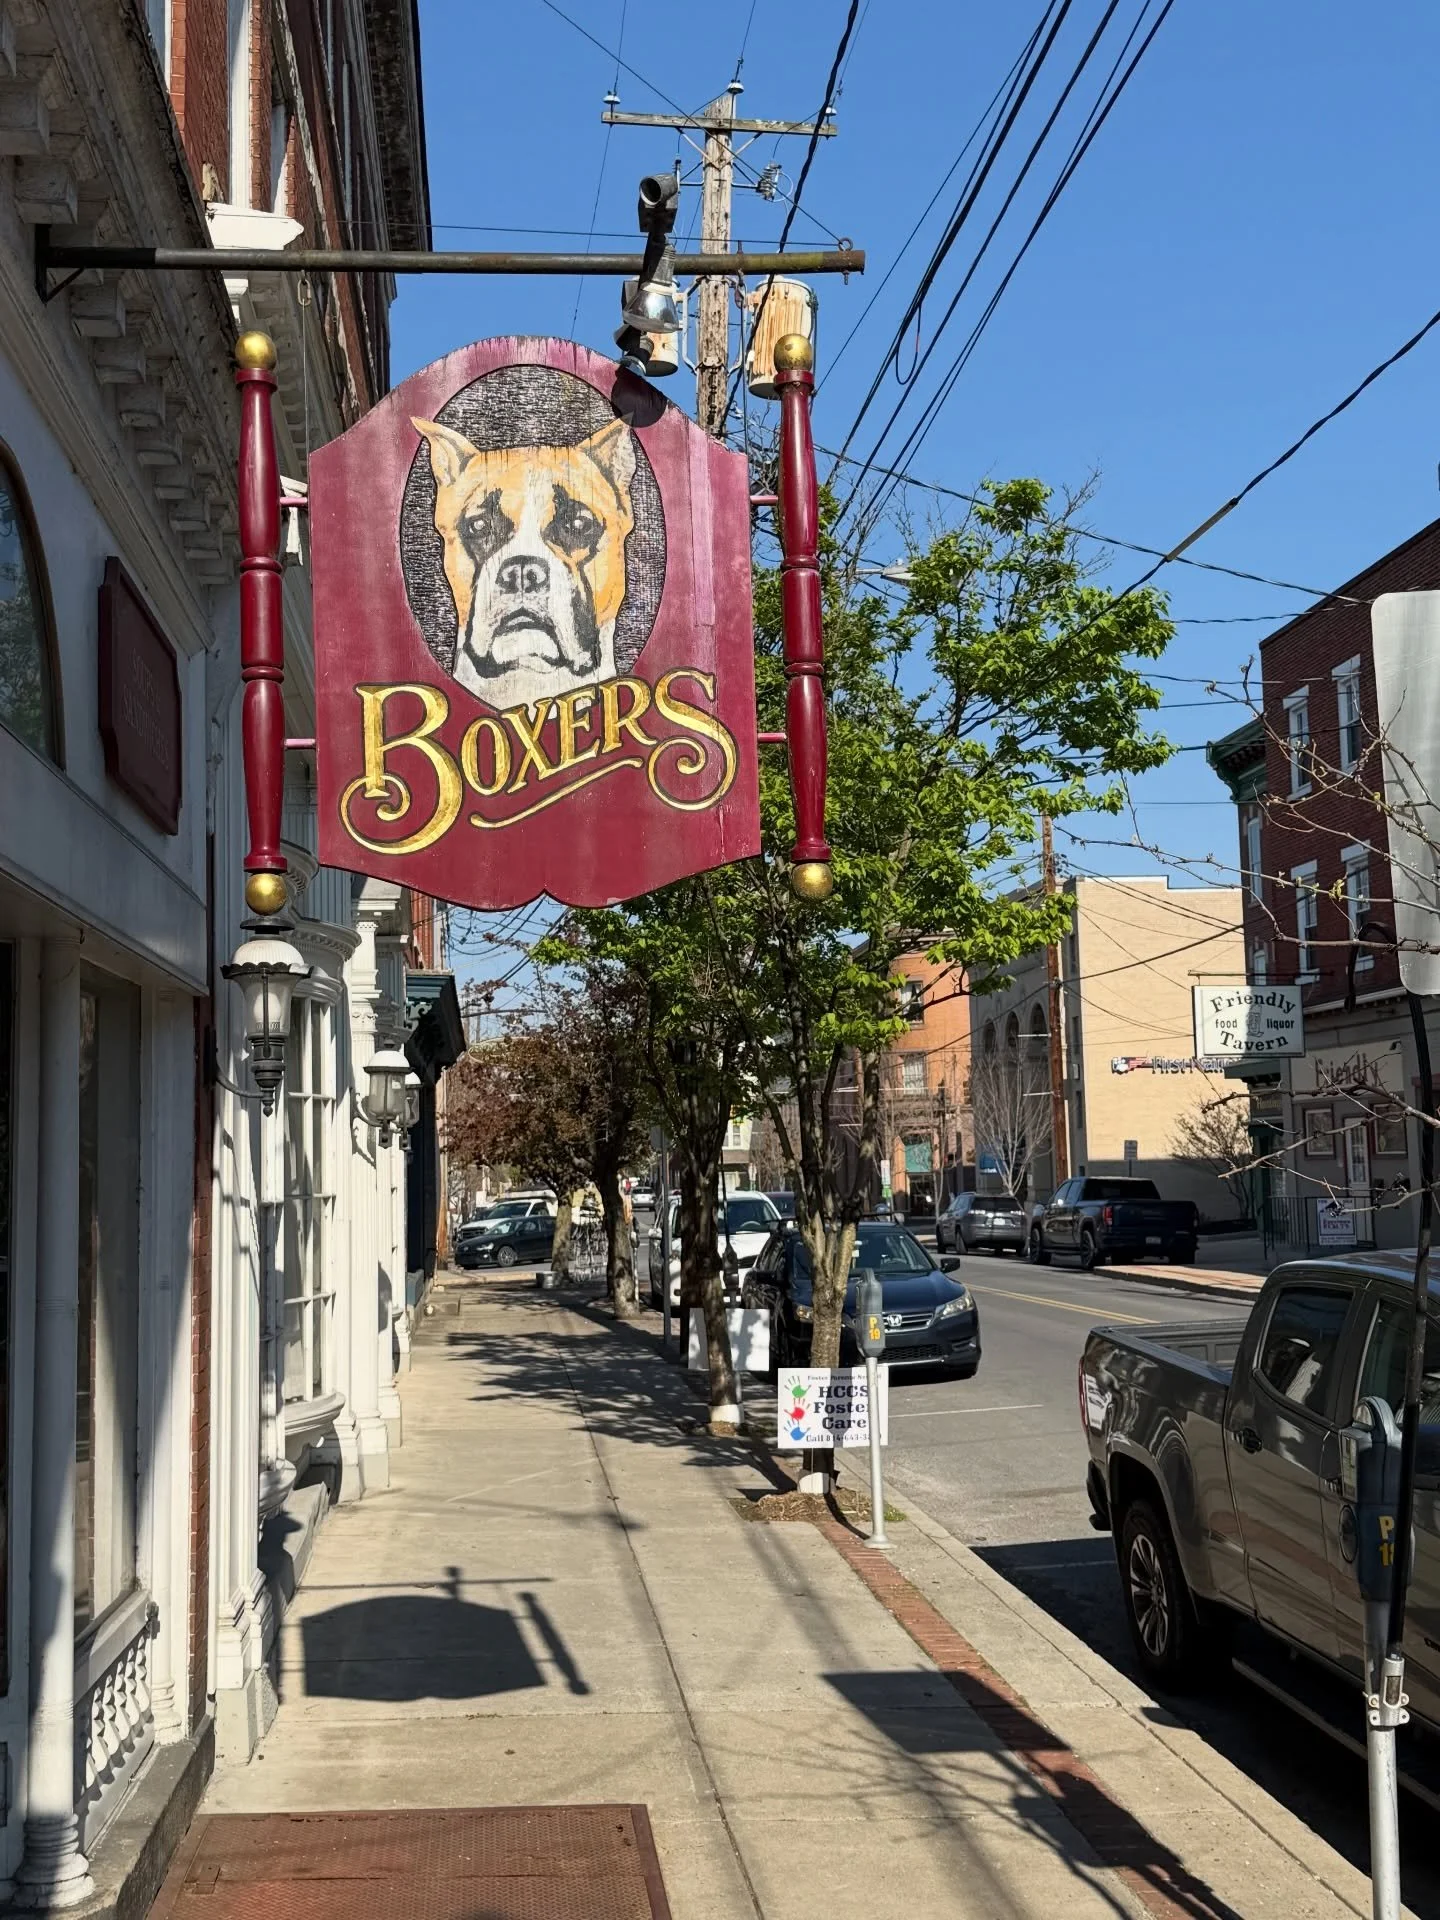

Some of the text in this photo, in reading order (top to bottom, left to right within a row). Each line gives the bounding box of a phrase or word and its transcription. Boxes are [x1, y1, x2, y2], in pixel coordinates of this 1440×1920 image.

[340, 668, 738, 855] BOXERS
[1210, 991, 1296, 1014] Friendly
[1215, 1018, 1295, 1031] food liquor
[1220, 1030, 1289, 1051] Tavern
[1152, 1056, 1187, 1074] First
[869, 1317, 878, 1328] P
[818, 1385, 869, 1398] HCCS
[822, 1416, 867, 1430] Care
[806, 1434, 824, 1442] Call
[1378, 1515, 1395, 1539] P
